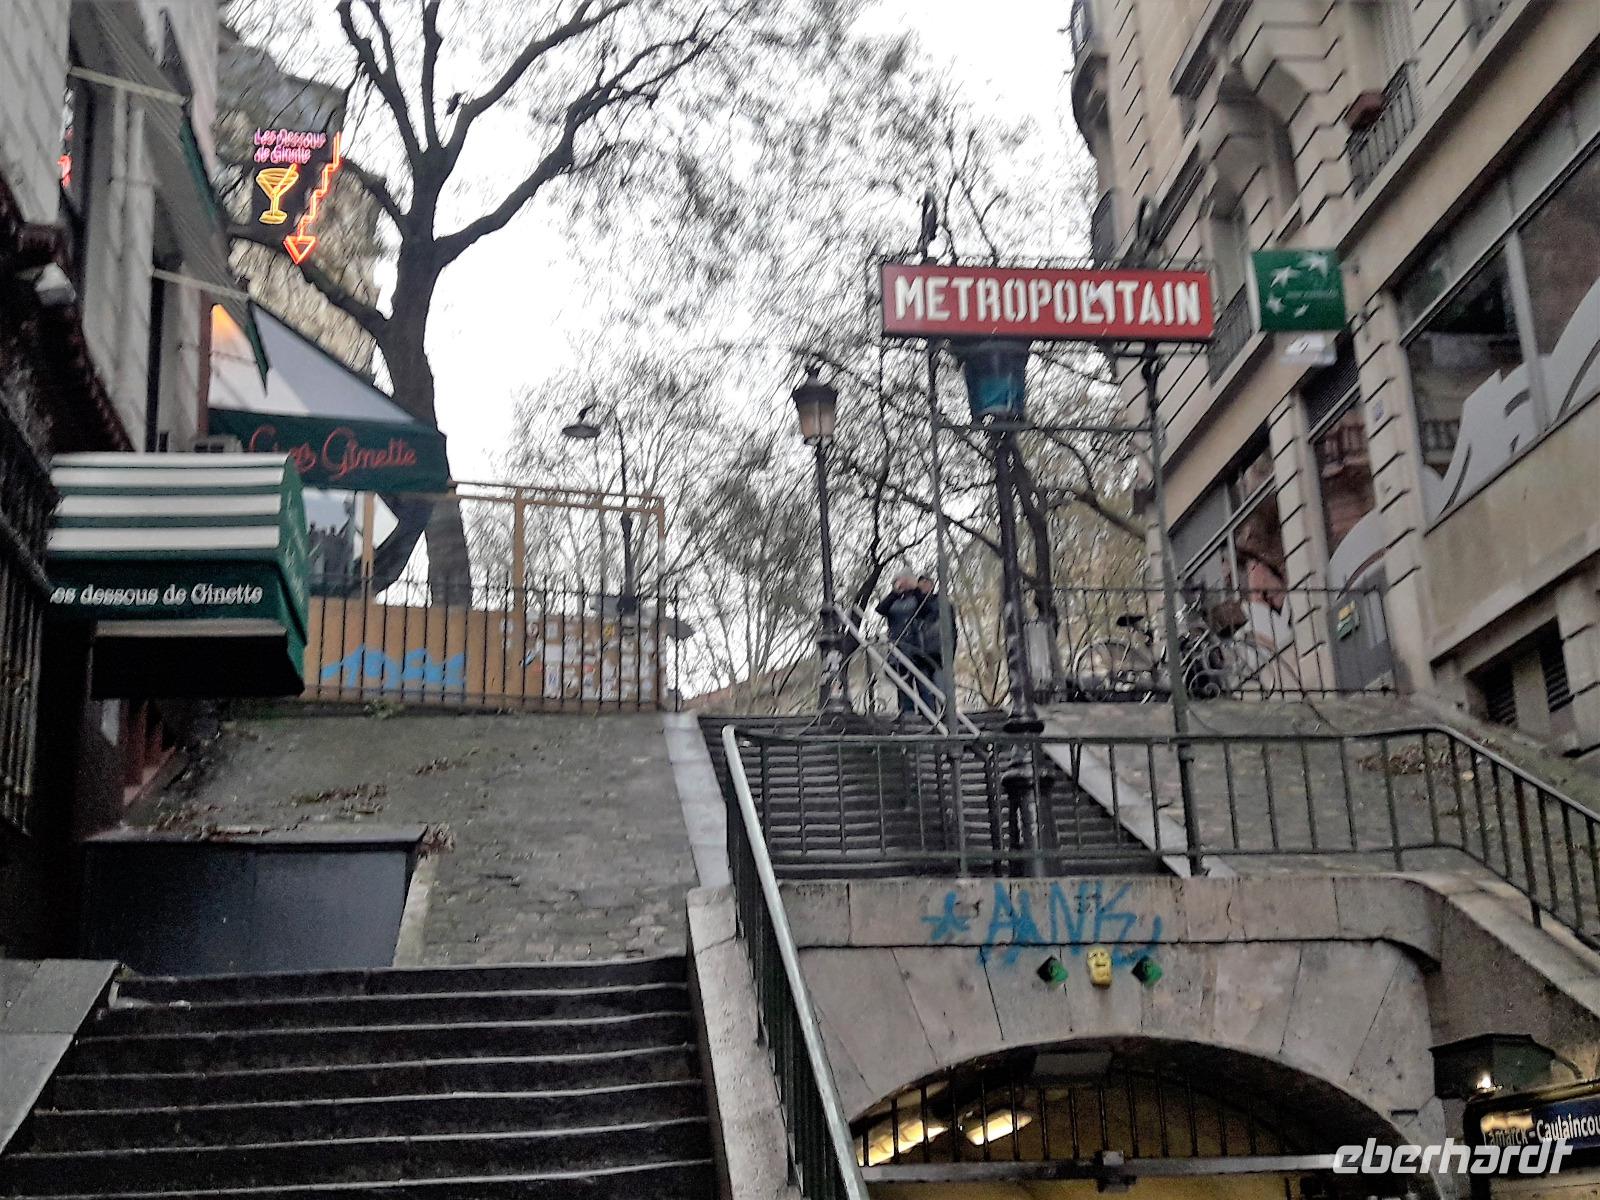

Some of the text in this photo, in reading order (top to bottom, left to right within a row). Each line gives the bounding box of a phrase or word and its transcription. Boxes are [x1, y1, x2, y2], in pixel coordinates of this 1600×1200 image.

[254, 127, 276, 146] Les
[254, 145, 271, 163] de
[894, 275, 1201, 326] METROPOLITAIN
[322, 426, 417, 481] Ginette
[50, 583, 264, 606] es dessous de Ginette
